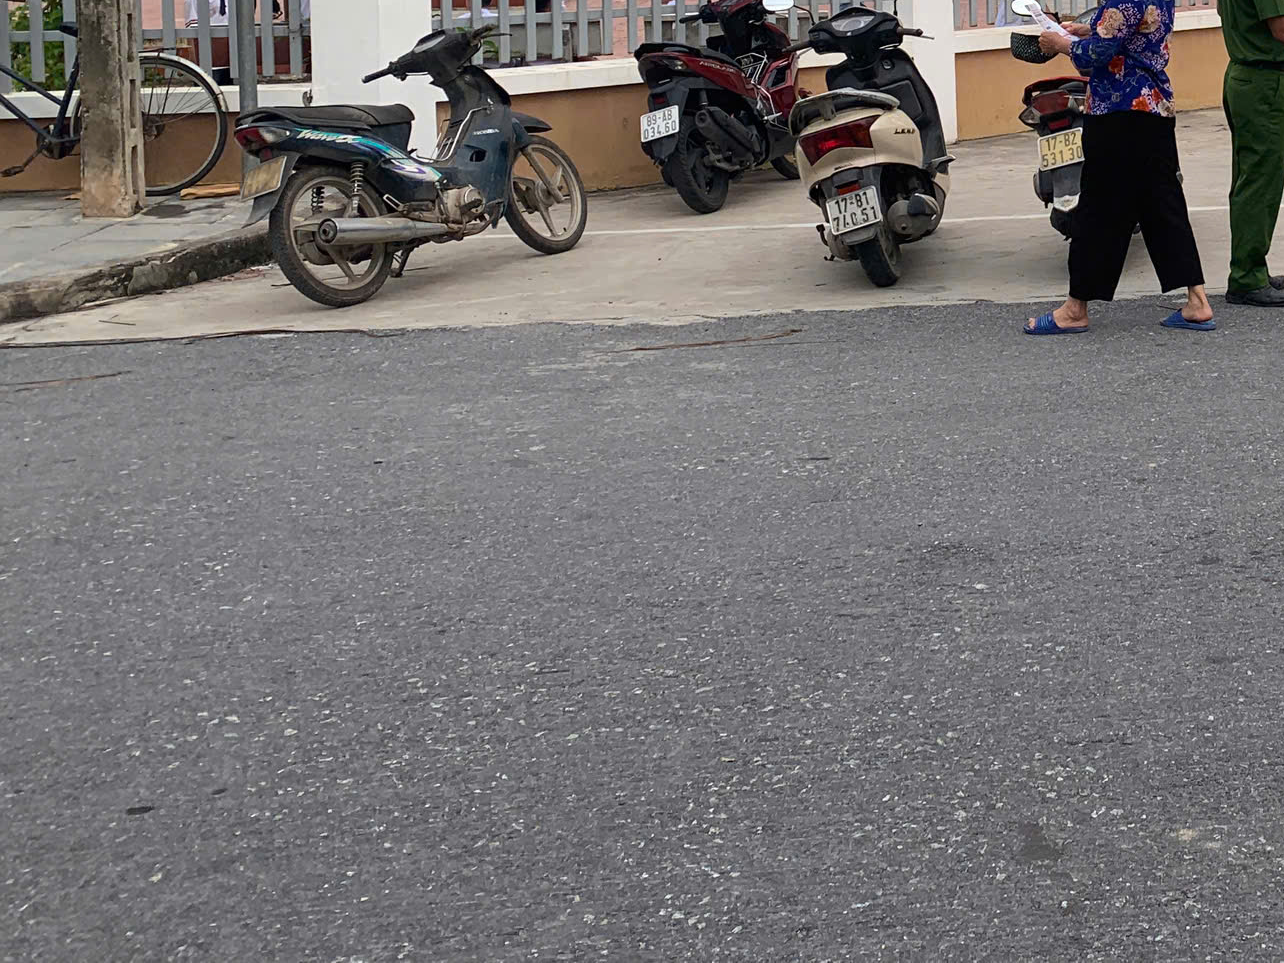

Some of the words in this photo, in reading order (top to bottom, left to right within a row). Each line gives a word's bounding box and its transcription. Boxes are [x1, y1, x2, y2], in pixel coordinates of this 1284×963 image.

[646, 109, 673, 127] 89-AB
[643, 120, 677, 140] 034.60
[1045, 132, 1078, 152] 17-B2
[1042, 146, 1083, 168] 531.30
[835, 191, 869, 214] 17-B1
